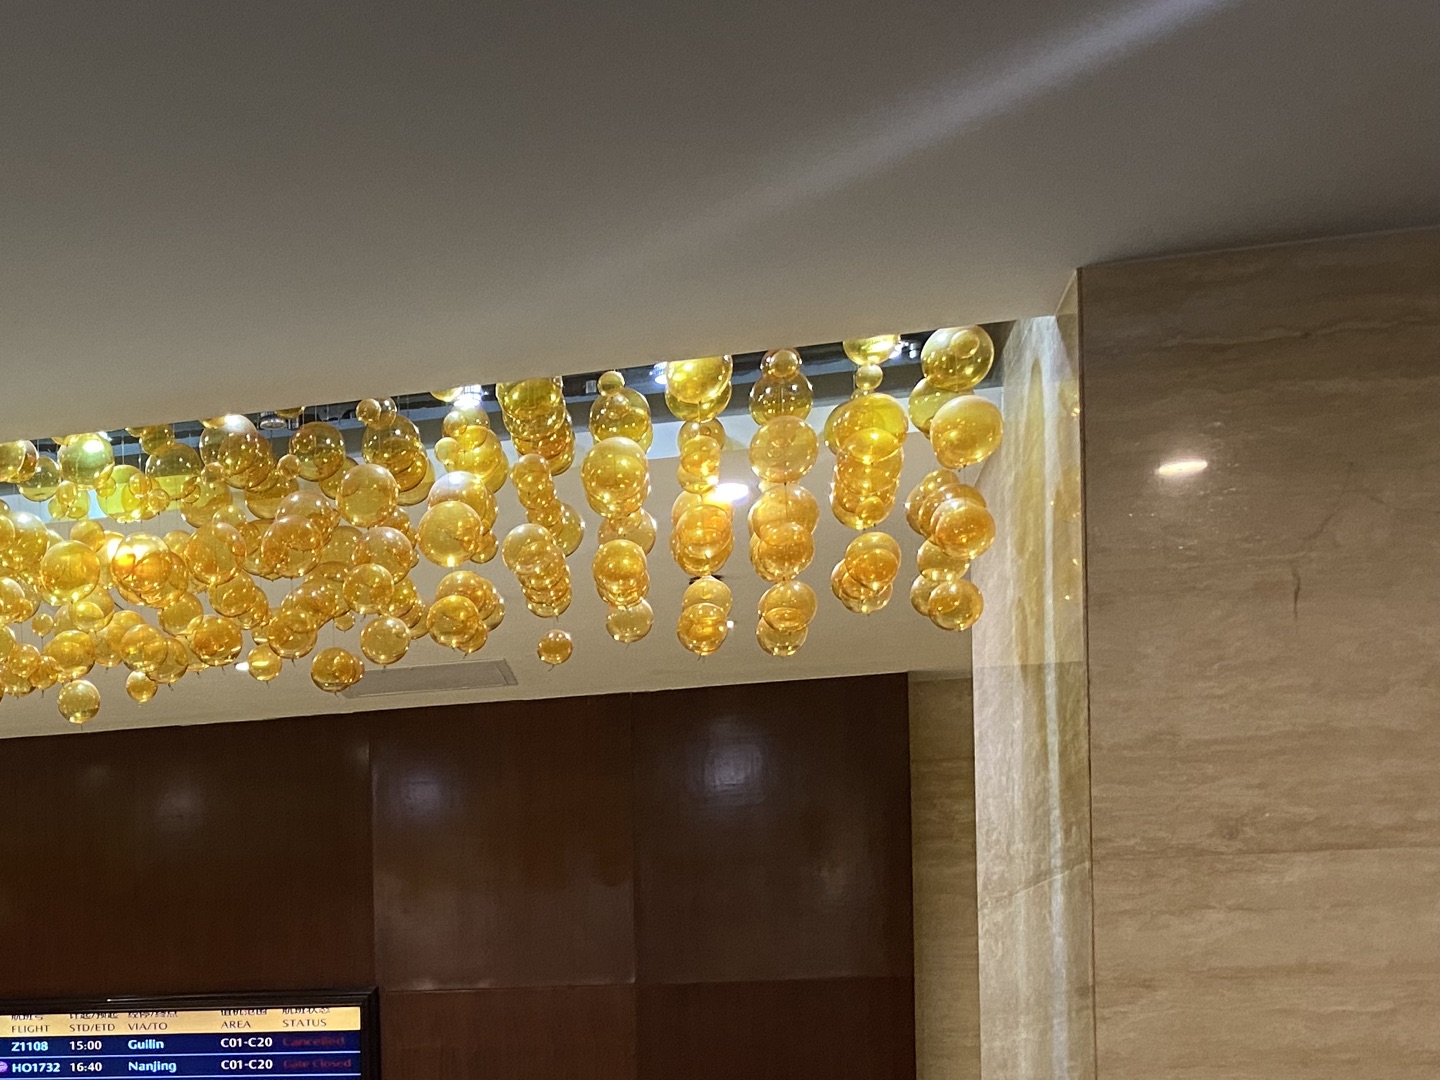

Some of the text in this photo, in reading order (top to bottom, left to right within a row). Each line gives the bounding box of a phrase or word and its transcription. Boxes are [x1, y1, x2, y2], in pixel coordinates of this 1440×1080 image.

[11, 1018, 327, 1033] FLIGHT STD/ETD VIA/TO AREA STATUS
[69, 1040, 102, 1051] 15:00
[127, 1039, 164, 1050] Guilin
[220, 1036, 273, 1048] C01-C20
[12, 1062, 61, 1073] HO1732
[70, 1062, 103, 1072] 16:40
[128, 1061, 177, 1073] Nanjing
[220, 1059, 273, 1070] C01-C20
[312, 1059, 352, 1068] Closed
